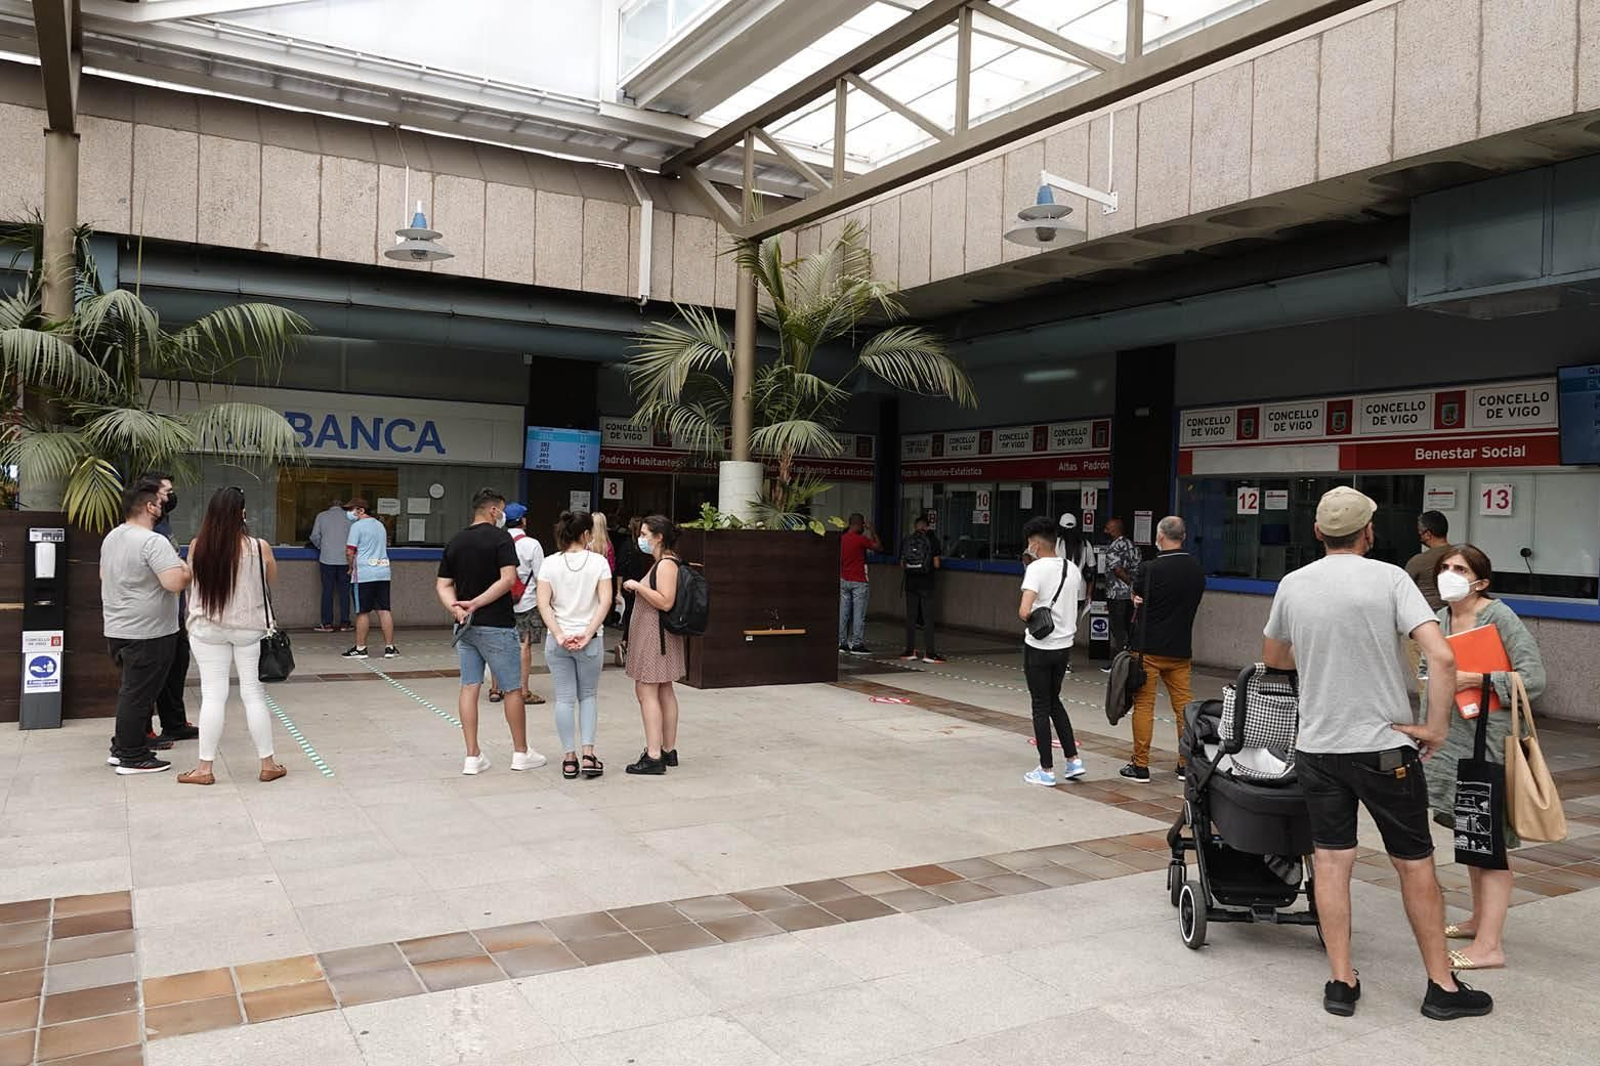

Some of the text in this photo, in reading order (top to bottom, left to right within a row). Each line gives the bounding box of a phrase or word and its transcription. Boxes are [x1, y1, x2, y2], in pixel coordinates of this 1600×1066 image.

[1479, 391, 1550, 407] CONCELLO
[1366, 401, 1426, 415] CONCELLO
[1486, 405, 1541, 419] DE VIGO
[1186, 415, 1231, 427] CONCELLO
[1268, 409, 1319, 421] CONCELLO
[1372, 413, 1418, 426] DE VIGO
[243, 411, 446, 454] BANCA
[605, 423, 648, 433] CONCELLO
[1191, 426, 1225, 437] DE VIGO
[1273, 420, 1313, 432] DE VIGO
[623, 432, 643, 441] VIGO
[998, 432, 1030, 442] CONCELLO
[1054, 428, 1088, 438] CONCELLO
[1057, 437, 1084, 446] DE VIGO
[600, 454, 631, 465] Padrón
[1415, 445, 1526, 461] Benestar Social
[1058, 459, 1110, 472] Altas Padrón
[609, 482, 617, 495] 8
[978, 493, 989, 507] 10
[1083, 491, 1096, 505] 11
[1239, 492, 1258, 509] 12
[1482, 489, 1510, 509] 13
